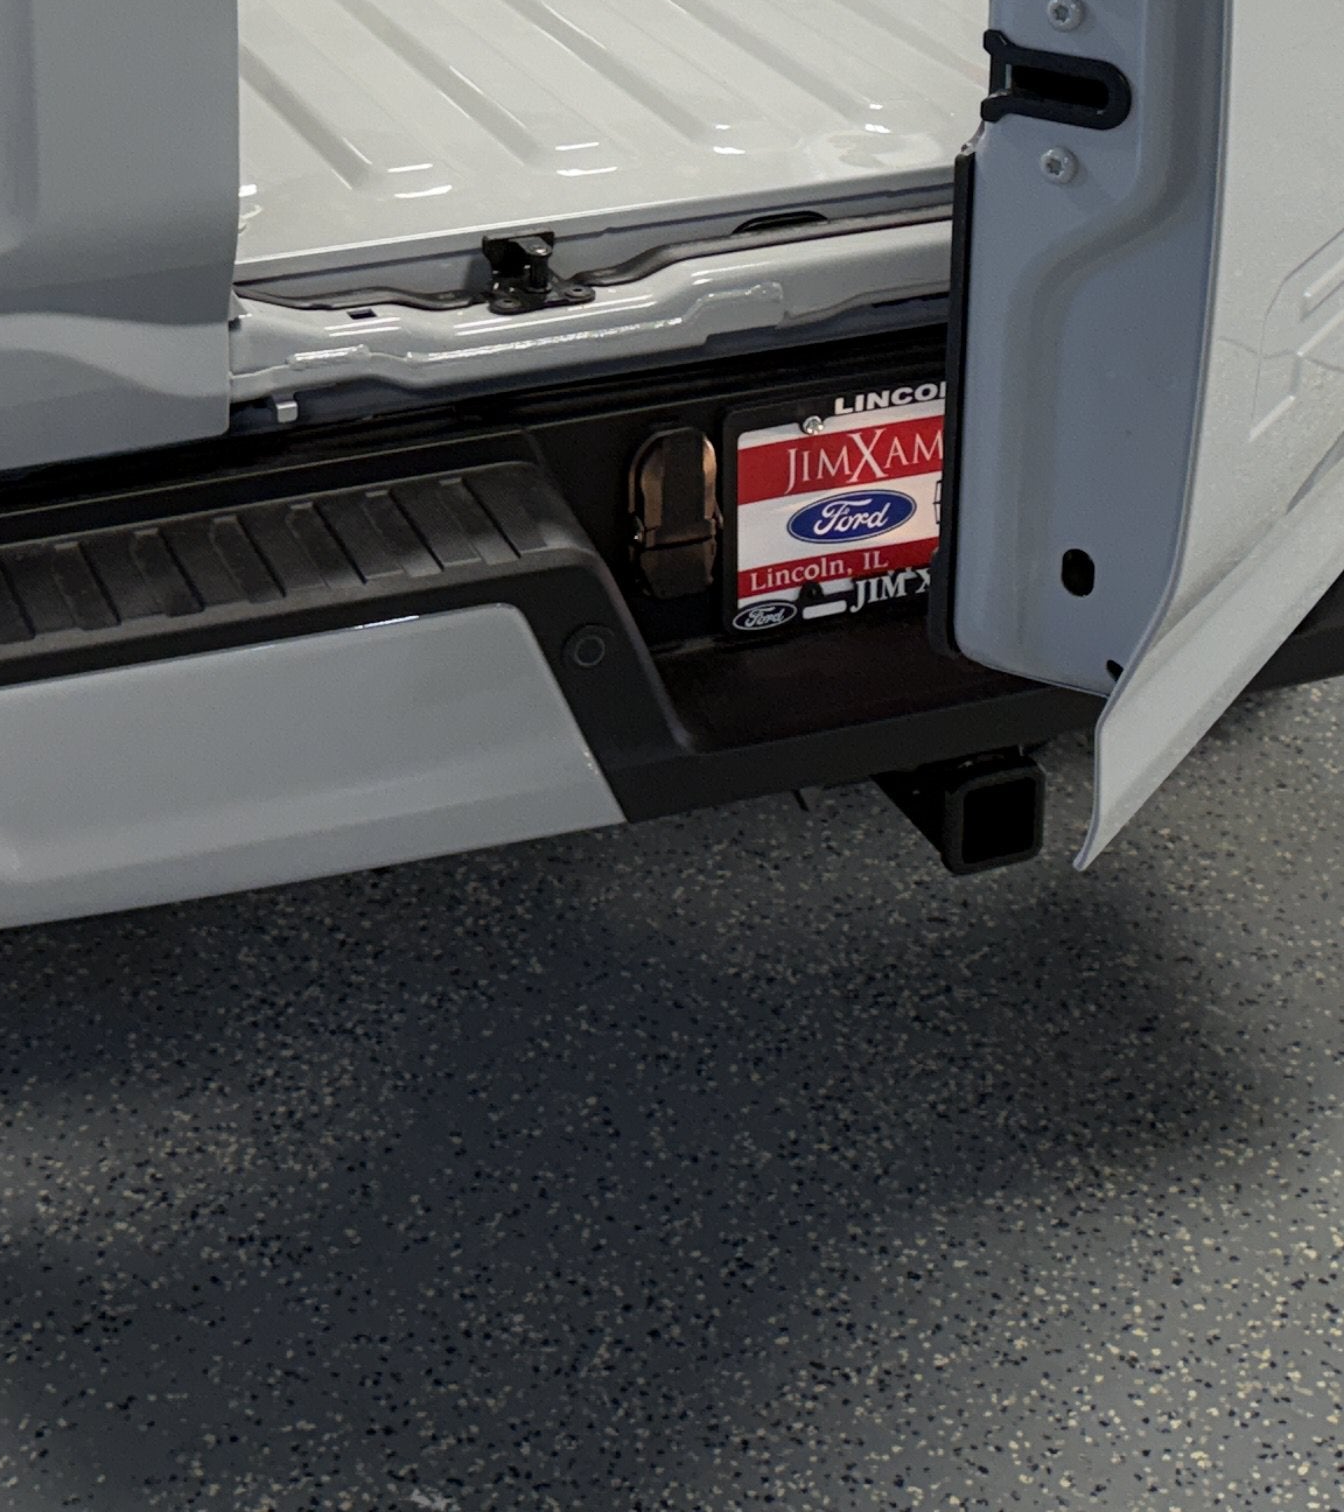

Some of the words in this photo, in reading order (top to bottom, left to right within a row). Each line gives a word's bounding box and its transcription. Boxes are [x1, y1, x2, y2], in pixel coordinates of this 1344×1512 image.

[834, 381, 946, 415] LINCO
[812, 497, 891, 535] Ford
[750, 557, 853, 592] Lincoln,
[863, 550, 889, 570] IL
[849, 571, 908, 613] JIM
[744, 607, 785, 627] Ford
